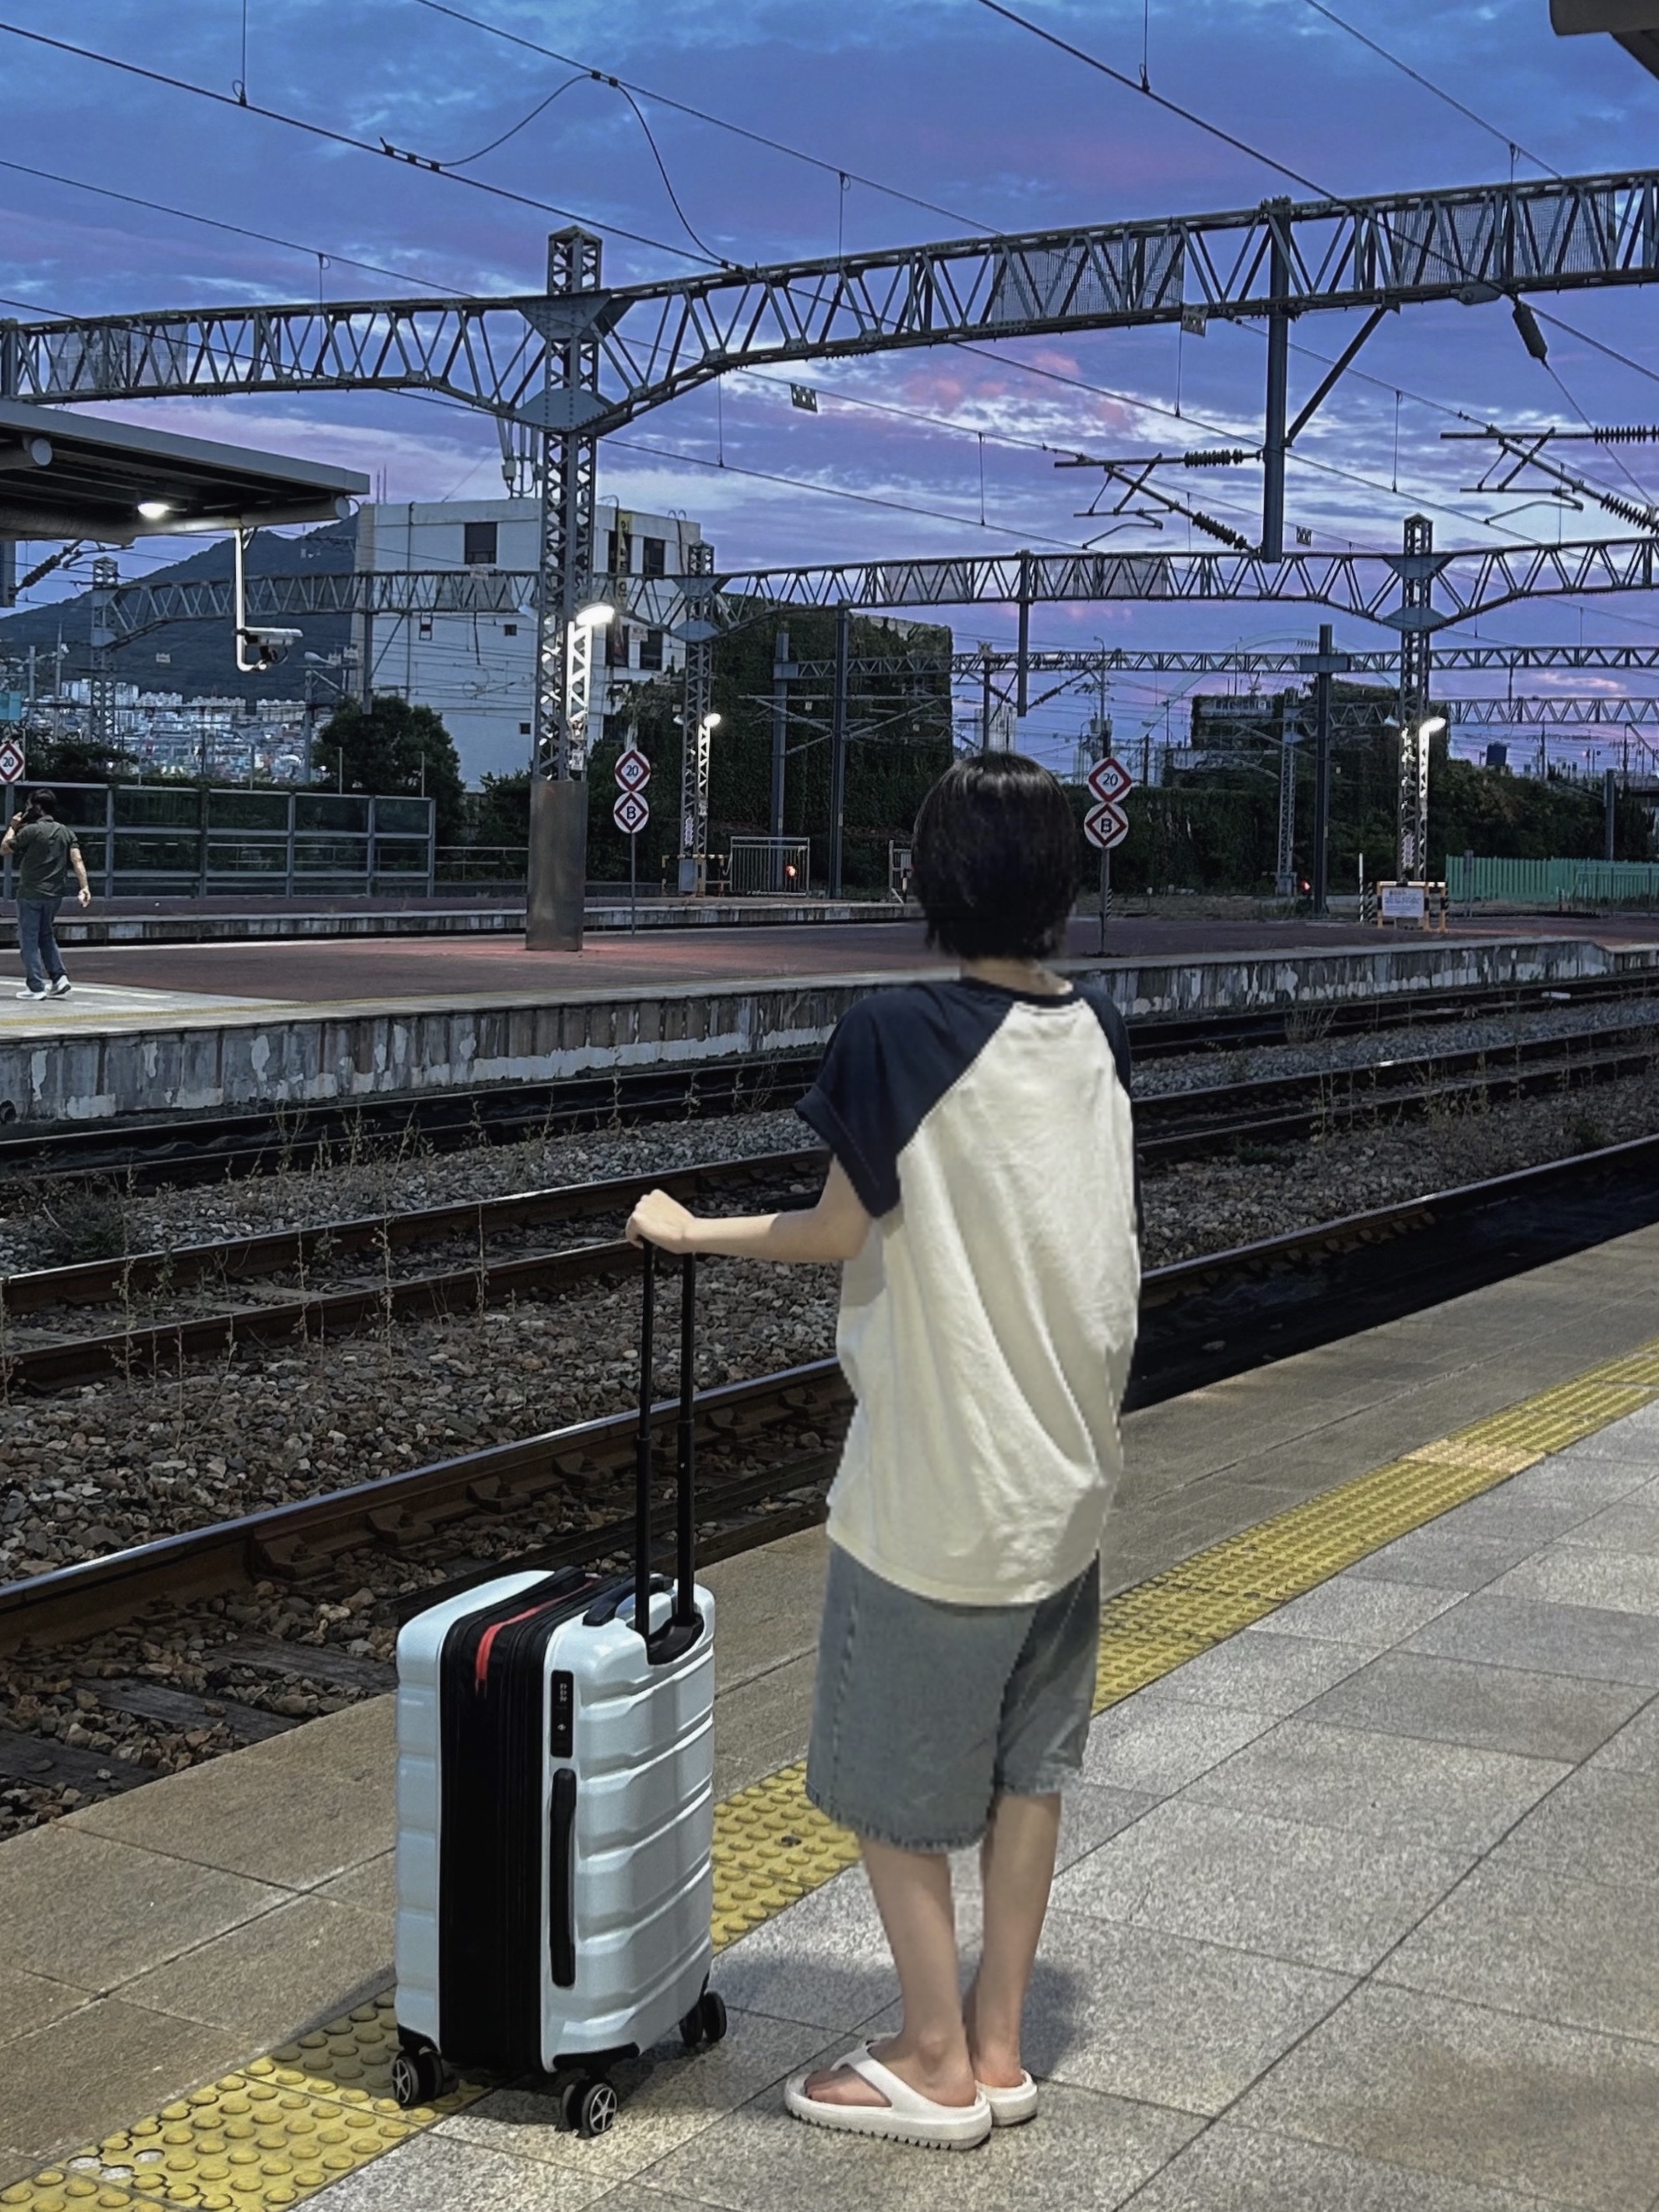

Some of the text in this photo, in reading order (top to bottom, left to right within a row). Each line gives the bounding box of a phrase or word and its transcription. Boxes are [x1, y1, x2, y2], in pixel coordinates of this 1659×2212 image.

[3, 757, 14, 767] 20
[625, 764, 639, 777] 20
[1102, 773, 1118, 786] 20
[626, 806, 636, 819] B
[1101, 818, 1112, 834] B
